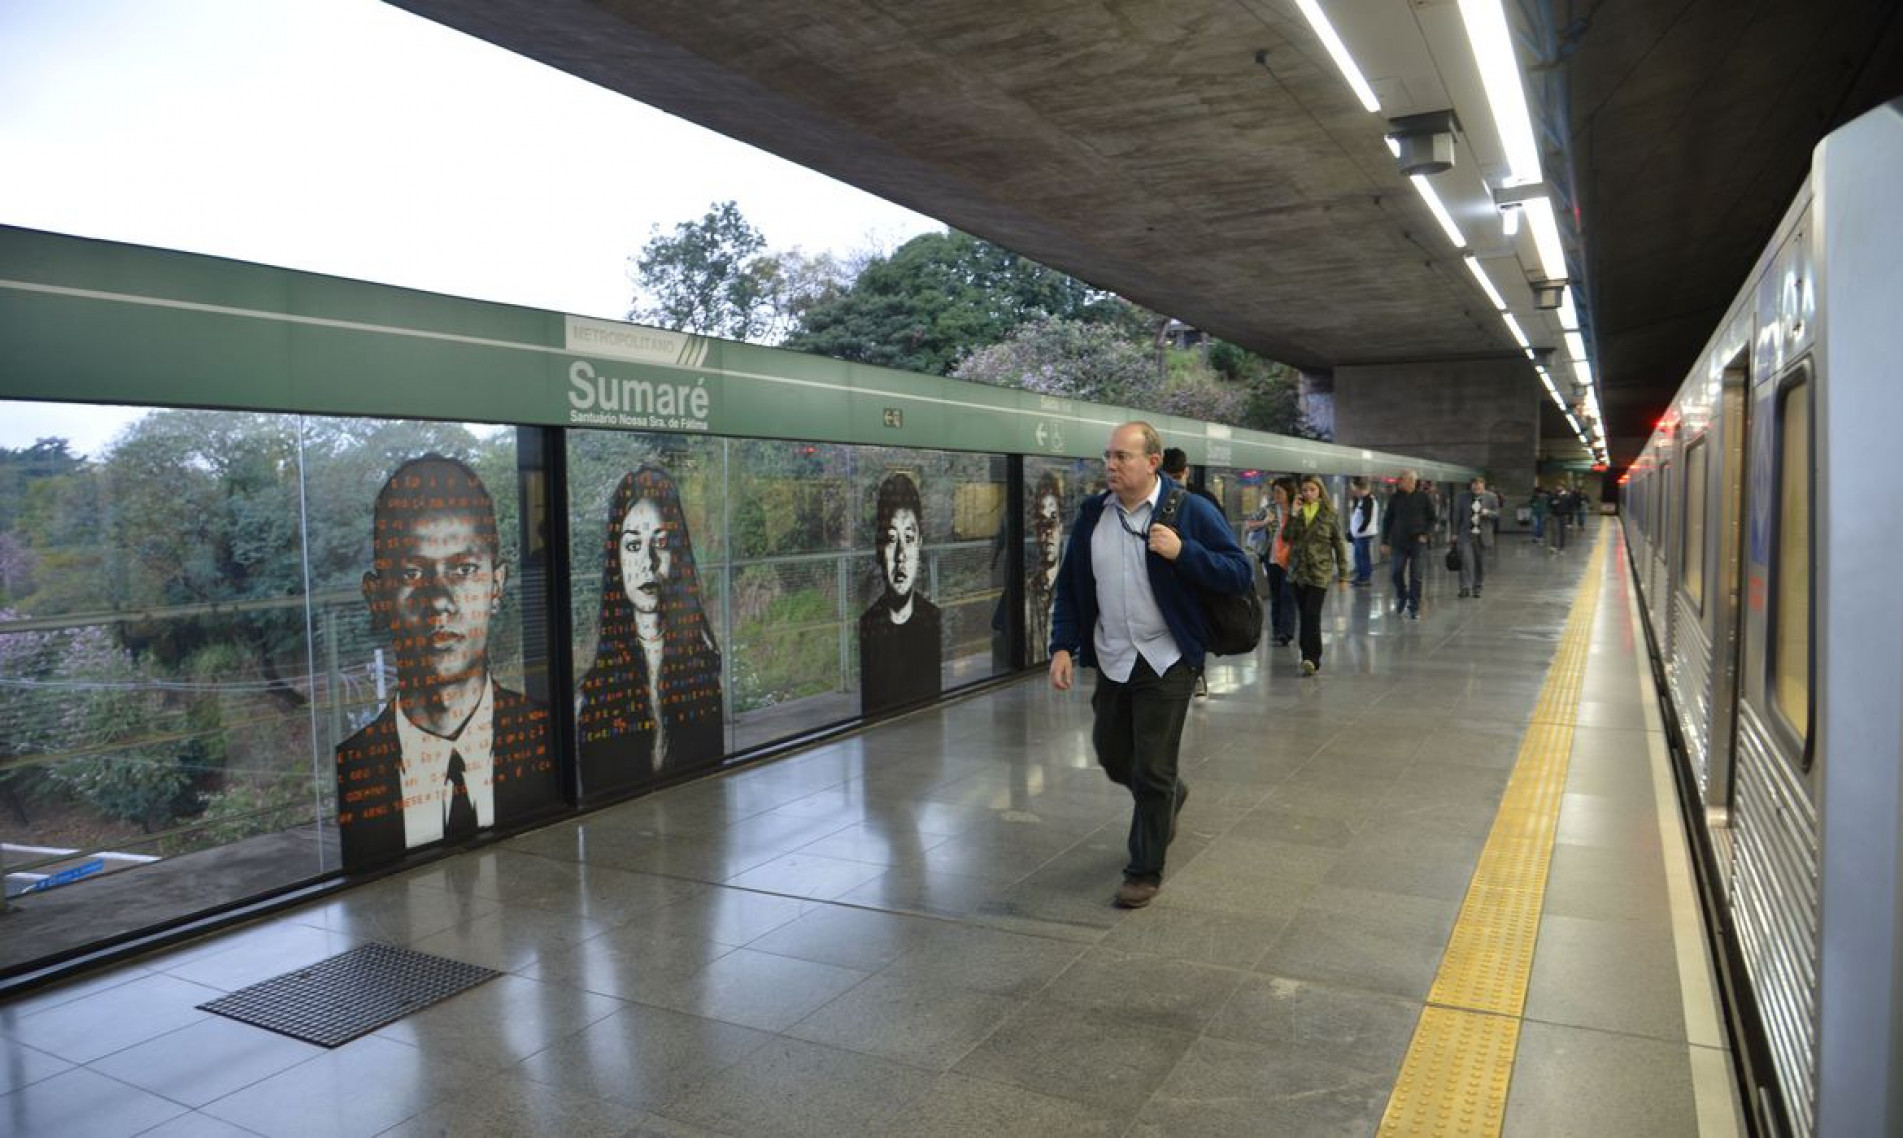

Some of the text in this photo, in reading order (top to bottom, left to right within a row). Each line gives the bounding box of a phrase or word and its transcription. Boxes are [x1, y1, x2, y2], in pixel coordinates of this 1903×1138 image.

[573, 325, 674, 352] METROPOLITANO
[568, 360, 710, 419] Sumaré
[570, 410, 618, 424] Santuário
[619, 413, 648, 427] Nossa
